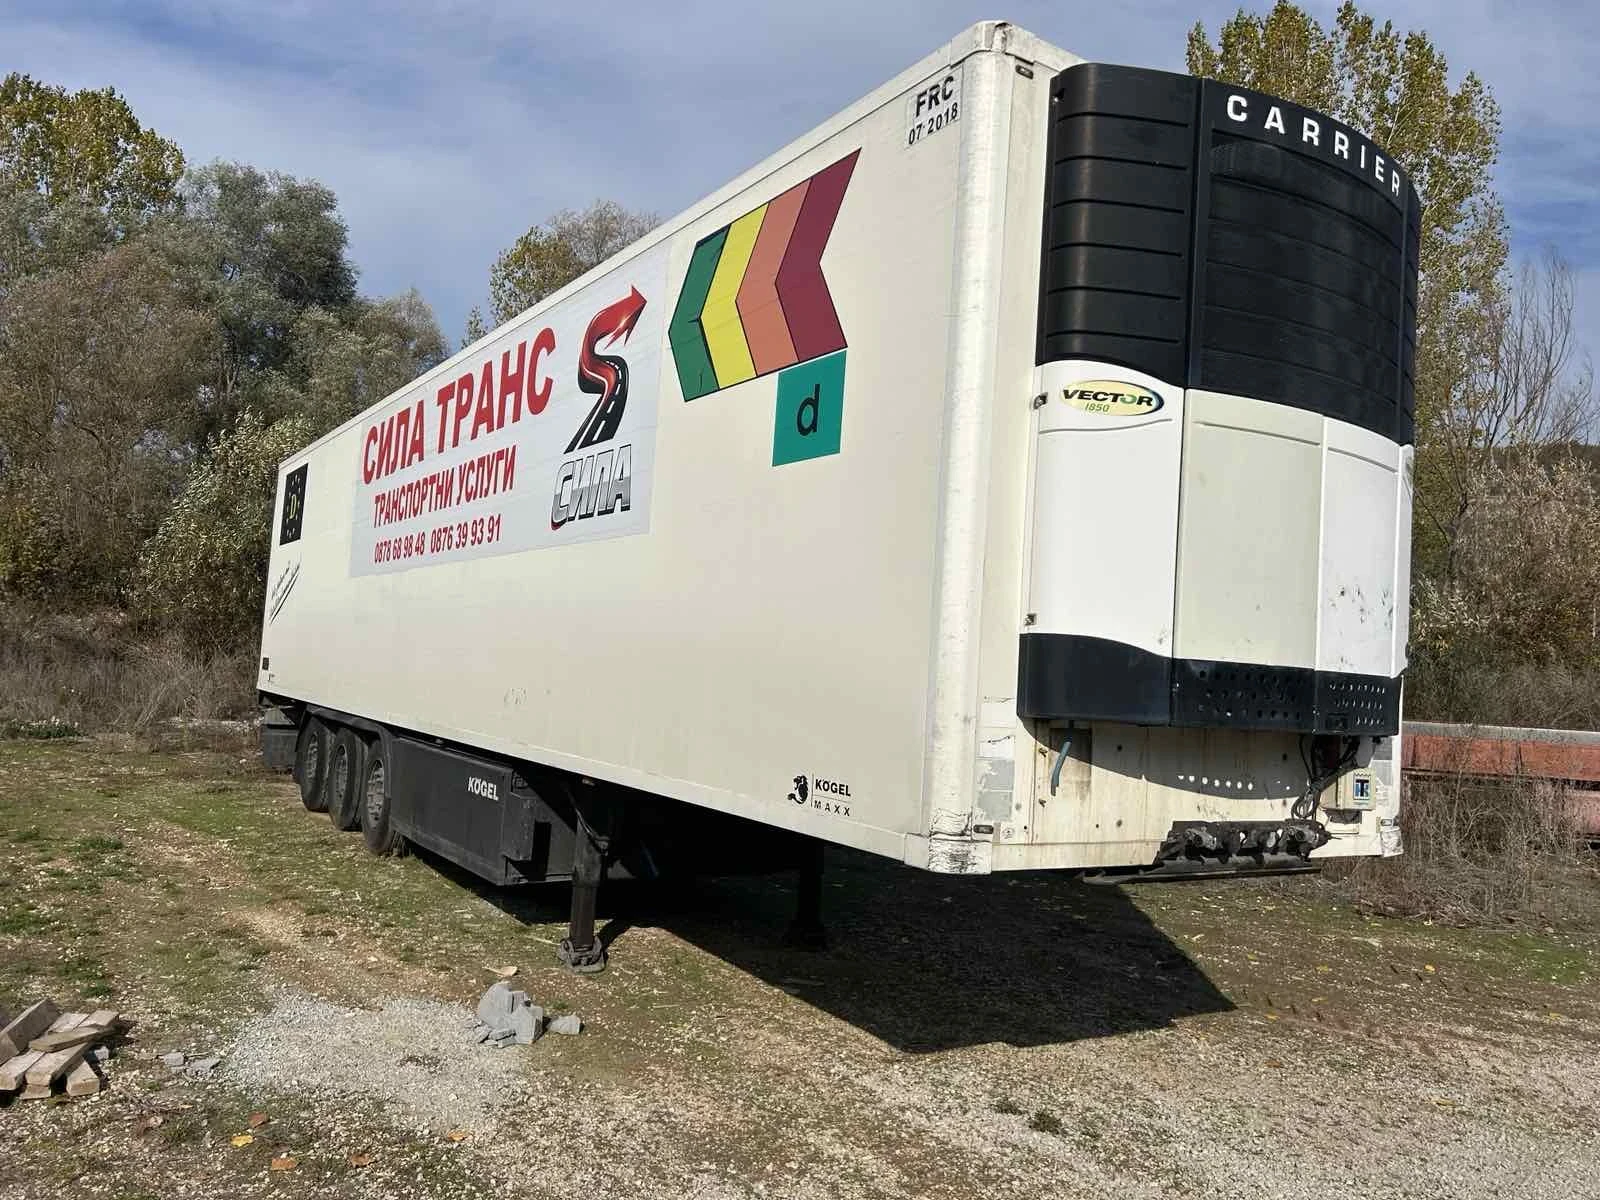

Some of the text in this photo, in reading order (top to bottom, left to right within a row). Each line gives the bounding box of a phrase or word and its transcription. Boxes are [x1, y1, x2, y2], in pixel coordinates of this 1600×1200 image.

[915, 76, 954, 118] FRC
[1226, 94, 1400, 197] CARRIER
[361, 327, 556, 485] СИЛА ТРАНС
[797, 384, 820, 436] d
[1062, 389, 1153, 406] VECTOR
[373, 444, 517, 529] ТРАНСПОРТНИ УСЛУГИ
[551, 443, 632, 531] СИЛА
[374, 513, 501, 564] 0878 68 98 48 0876 39 93 91
[467, 776, 499, 801] KÖGEL
[814, 800, 850, 816] MAXX
[815, 778, 851, 797] KÖGEL
